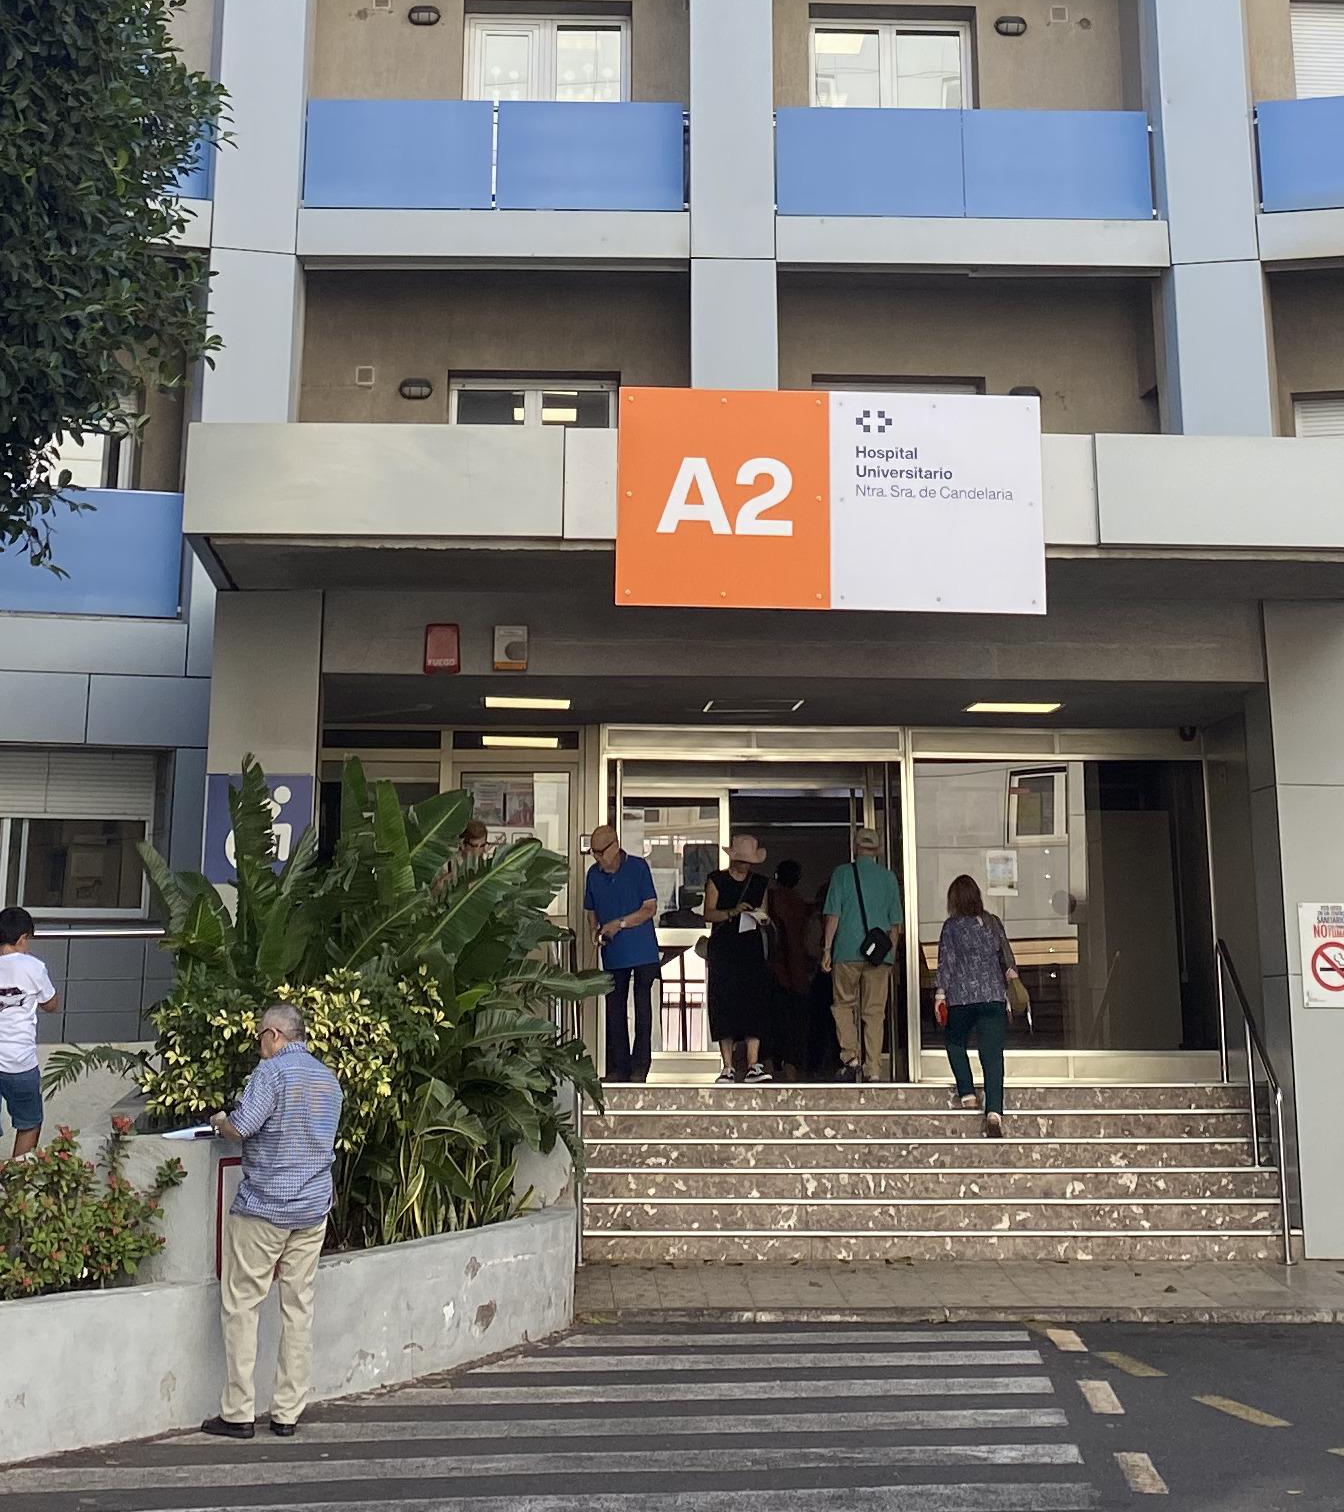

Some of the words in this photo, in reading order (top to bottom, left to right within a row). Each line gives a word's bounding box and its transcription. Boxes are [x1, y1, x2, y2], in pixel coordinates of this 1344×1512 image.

[855, 445, 918, 461] Hospital
[855, 465, 953, 480] Universitario
[656, 456, 793, 536] A2
[855, 484, 887, 498] Ntra.
[890, 484, 916, 498] Sra.
[919, 485, 937, 499] de
[940, 486, 1014, 501] Candelaria
[1313, 924, 1327, 938] NO
